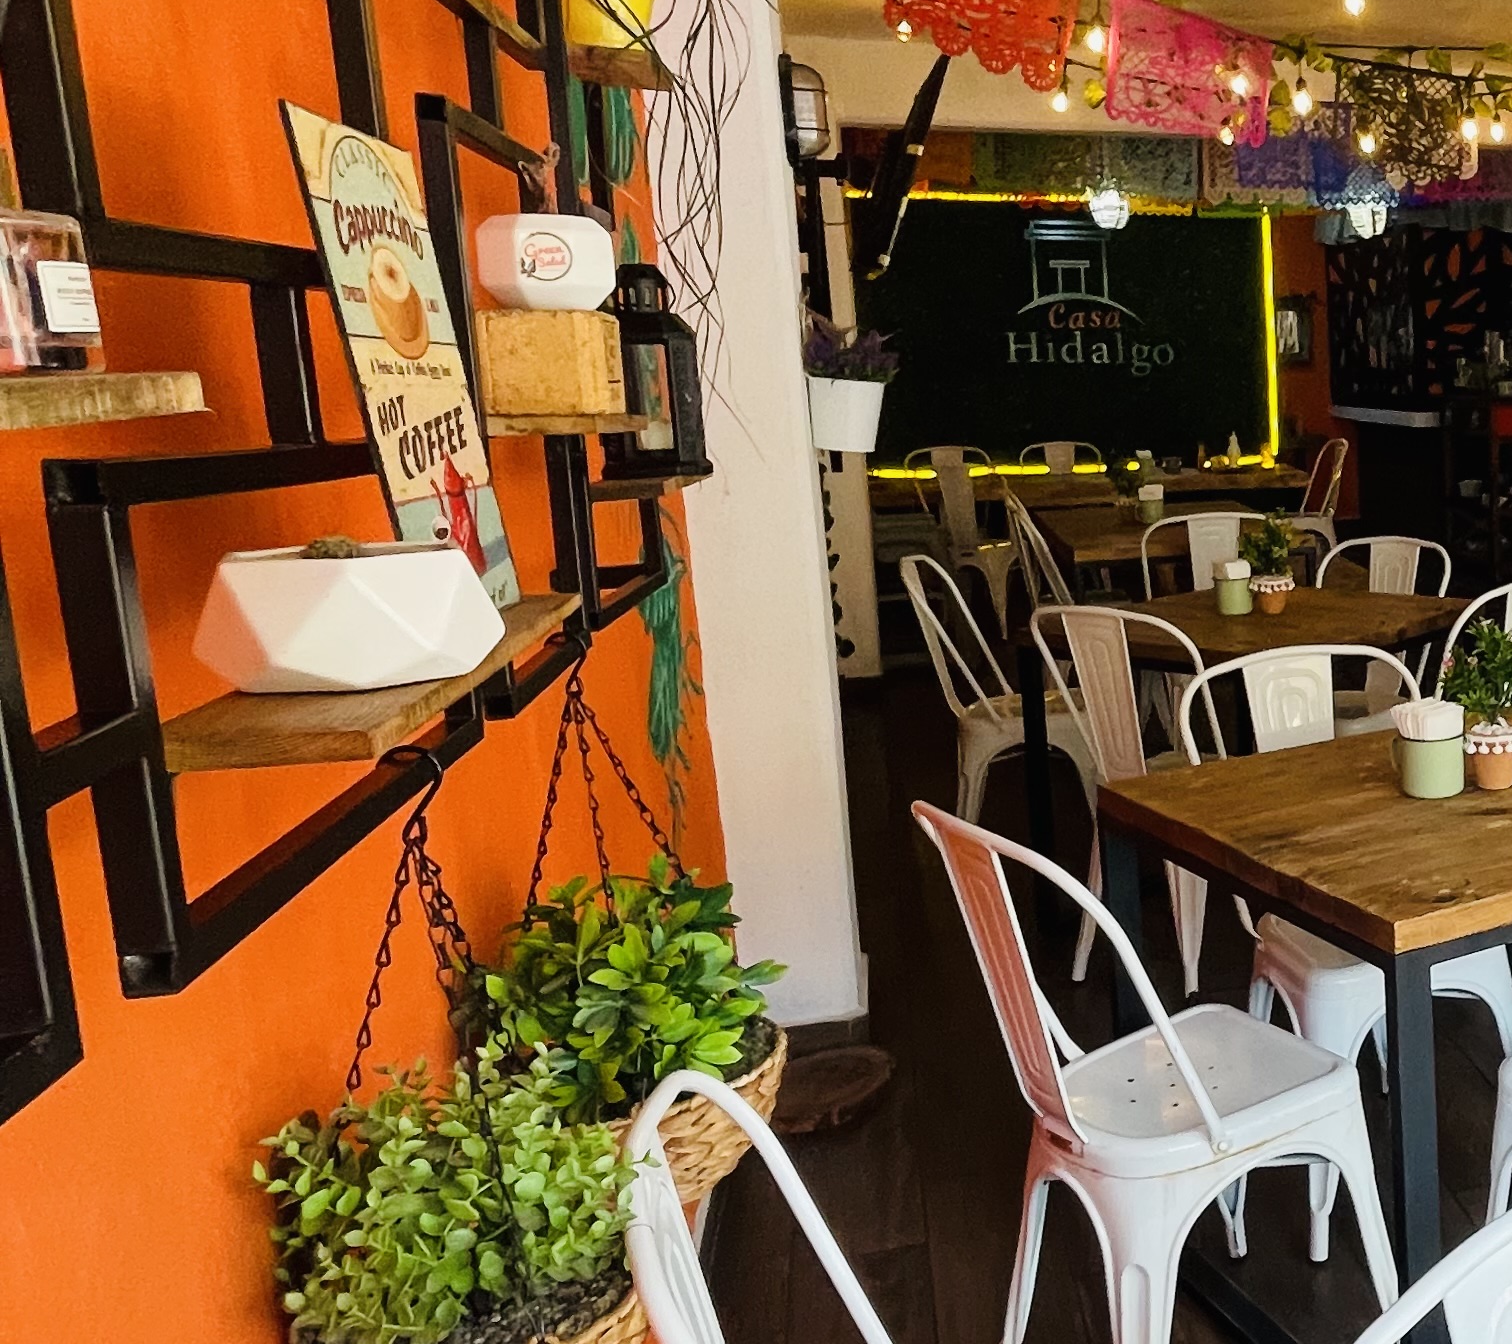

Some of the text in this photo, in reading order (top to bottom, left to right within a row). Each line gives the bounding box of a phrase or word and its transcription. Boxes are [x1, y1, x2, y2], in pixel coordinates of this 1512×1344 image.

[333, 199, 424, 260] Cappuccino
[1048, 303, 1121, 329] Casa
[1006, 330, 1175, 376] Hidalgo
[377, 395, 406, 436] HOT
[399, 406, 467, 480] COFFEE
